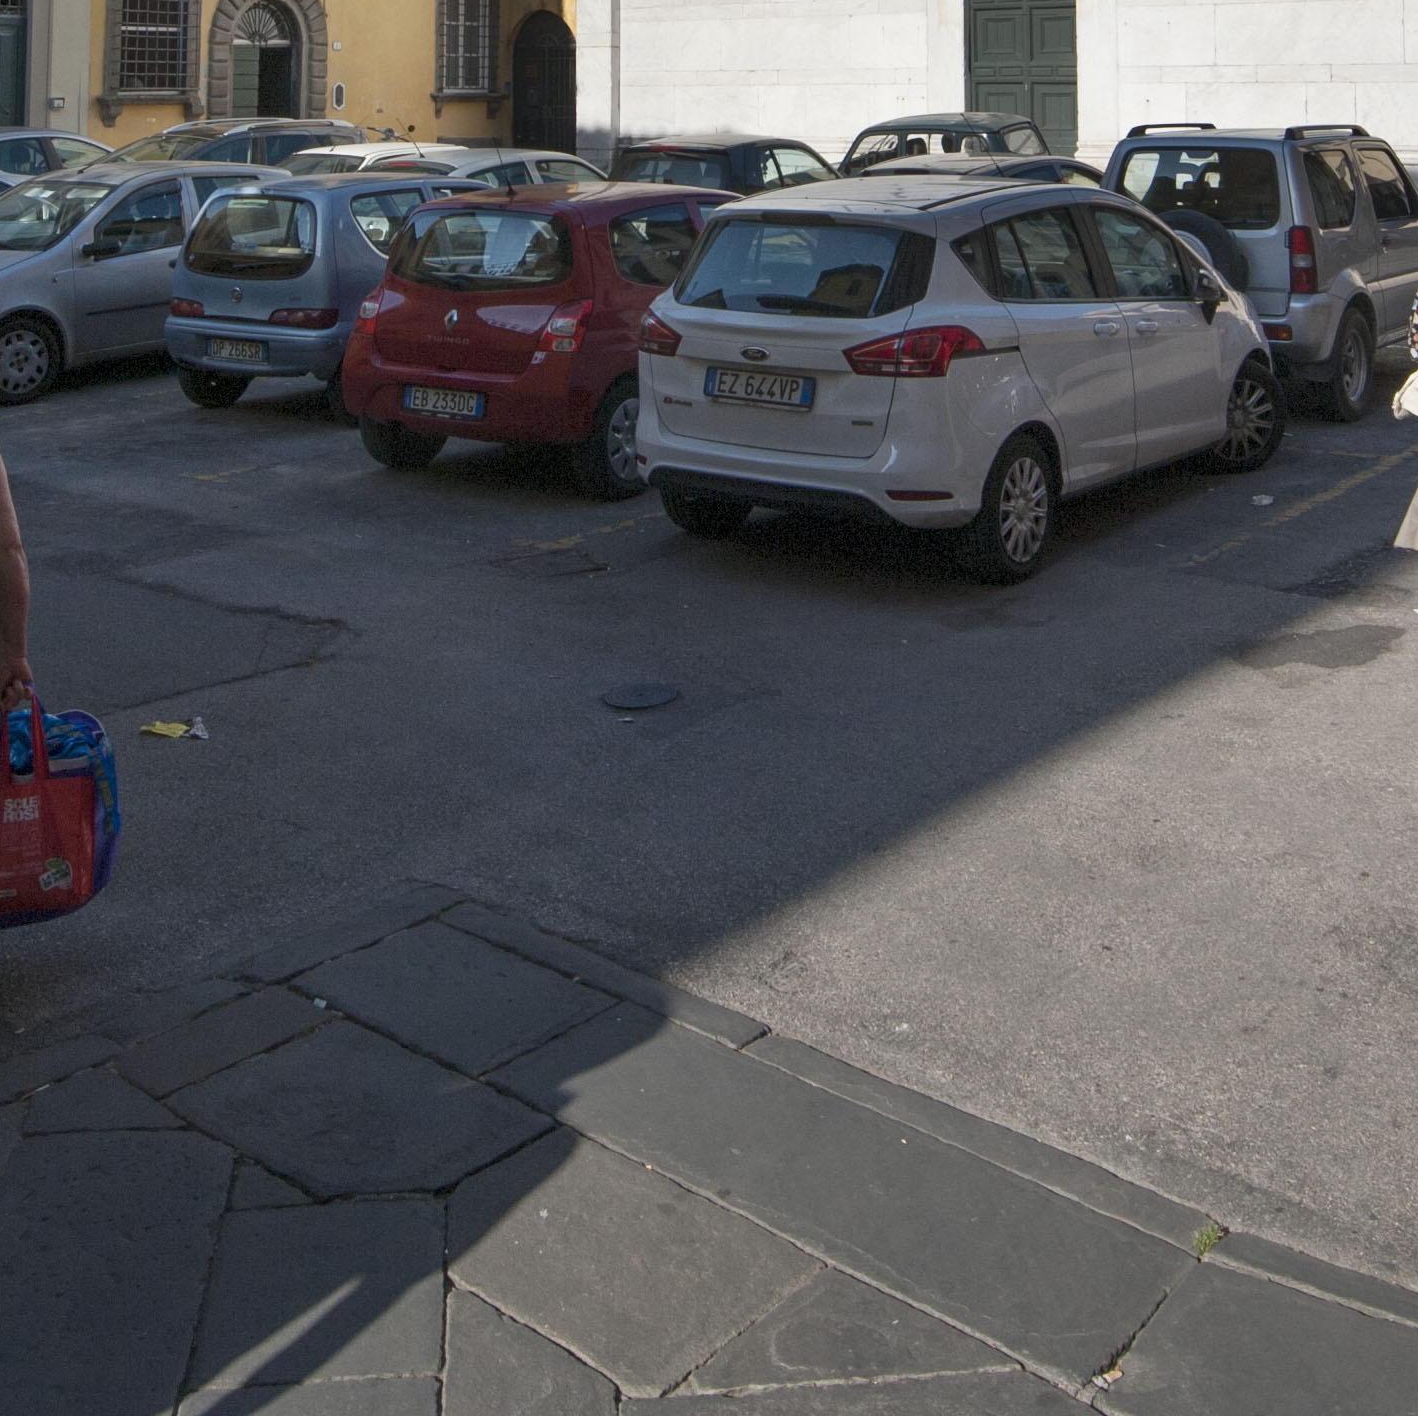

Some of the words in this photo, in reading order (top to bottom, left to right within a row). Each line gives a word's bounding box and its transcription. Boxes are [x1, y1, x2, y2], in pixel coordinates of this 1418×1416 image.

[213, 339, 224, 355] DP
[228, 342, 261, 360] 266SR
[426, 334, 470, 345] TWINGO
[717, 372, 740, 394] EZ
[744, 375, 800, 401] 644VP
[412, 389, 429, 407] EB
[432, 391, 475, 413] 233DG
